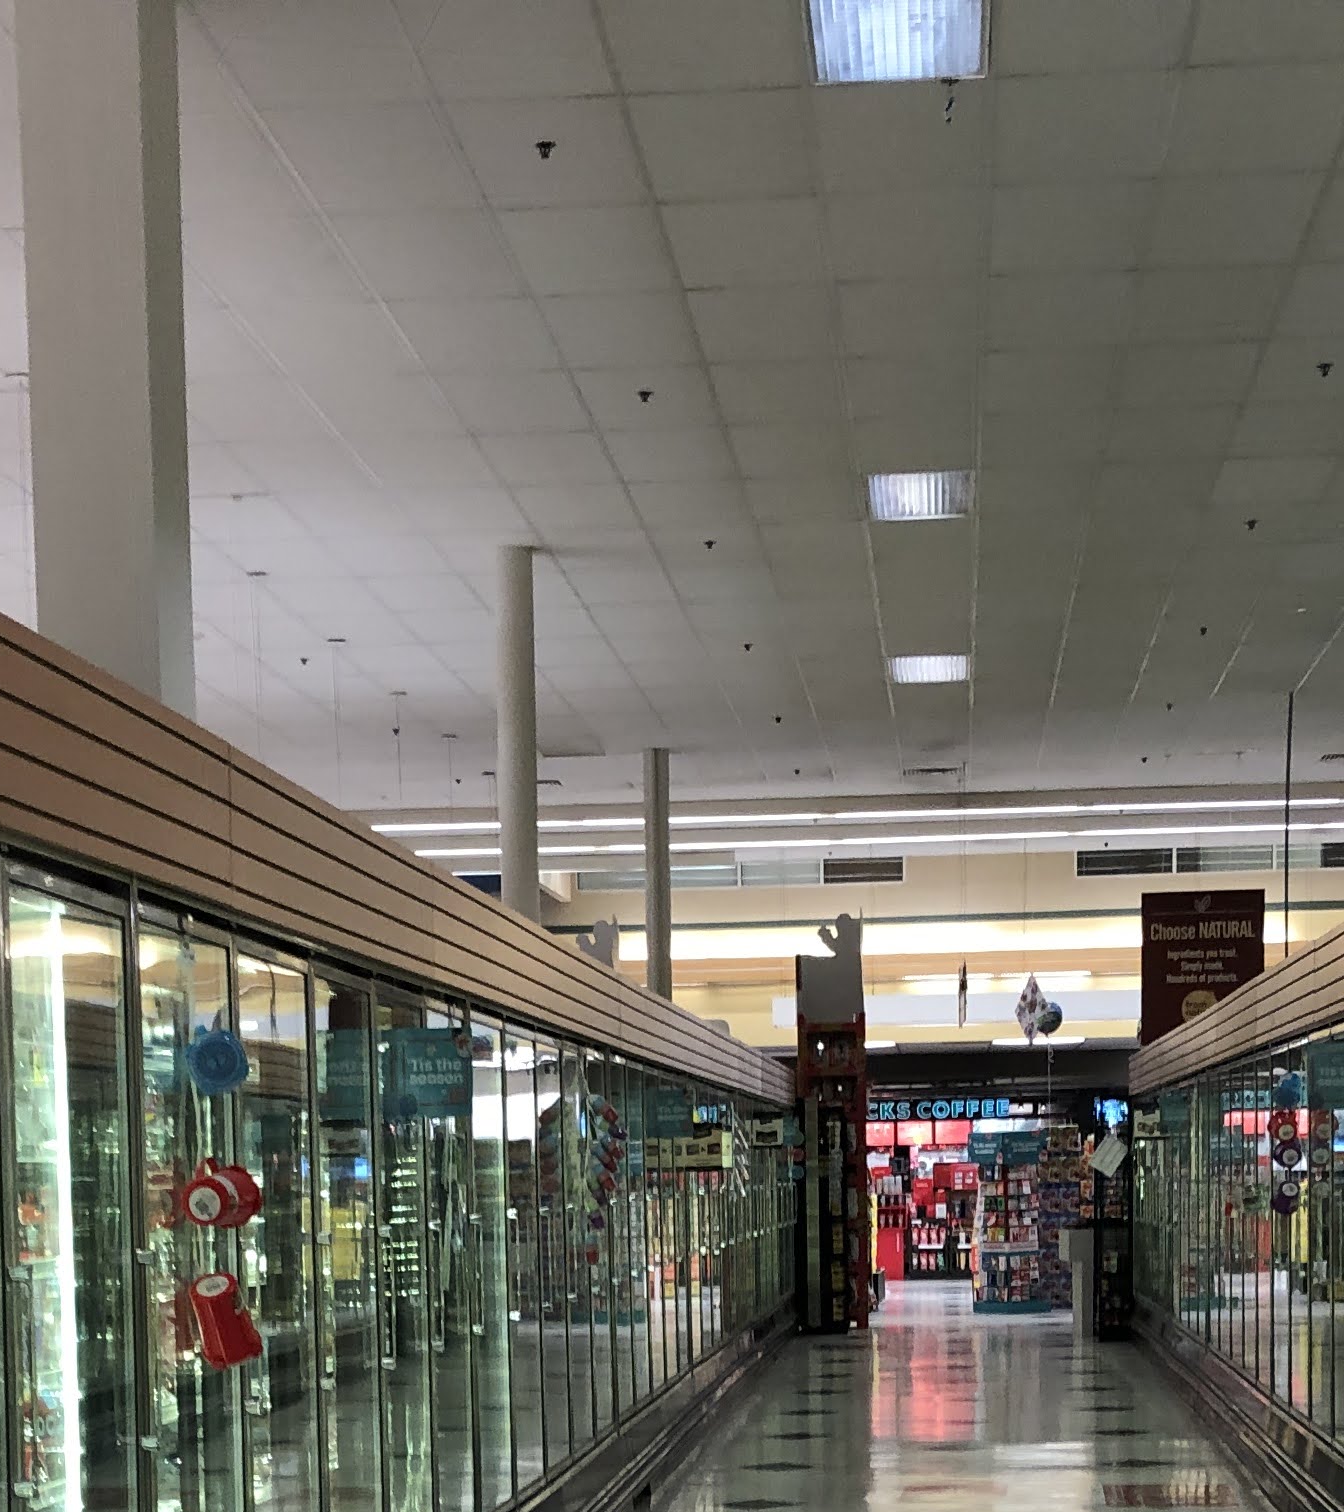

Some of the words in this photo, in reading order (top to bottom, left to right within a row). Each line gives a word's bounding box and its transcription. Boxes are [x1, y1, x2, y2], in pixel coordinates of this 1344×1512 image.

[1150, 922, 1196, 941] Choose
[1198, 920, 1256, 939] NATURAL
[436, 1057, 463, 1072] the
[409, 1072, 464, 1085] season
[916, 1098, 1010, 1119] COFFEE
